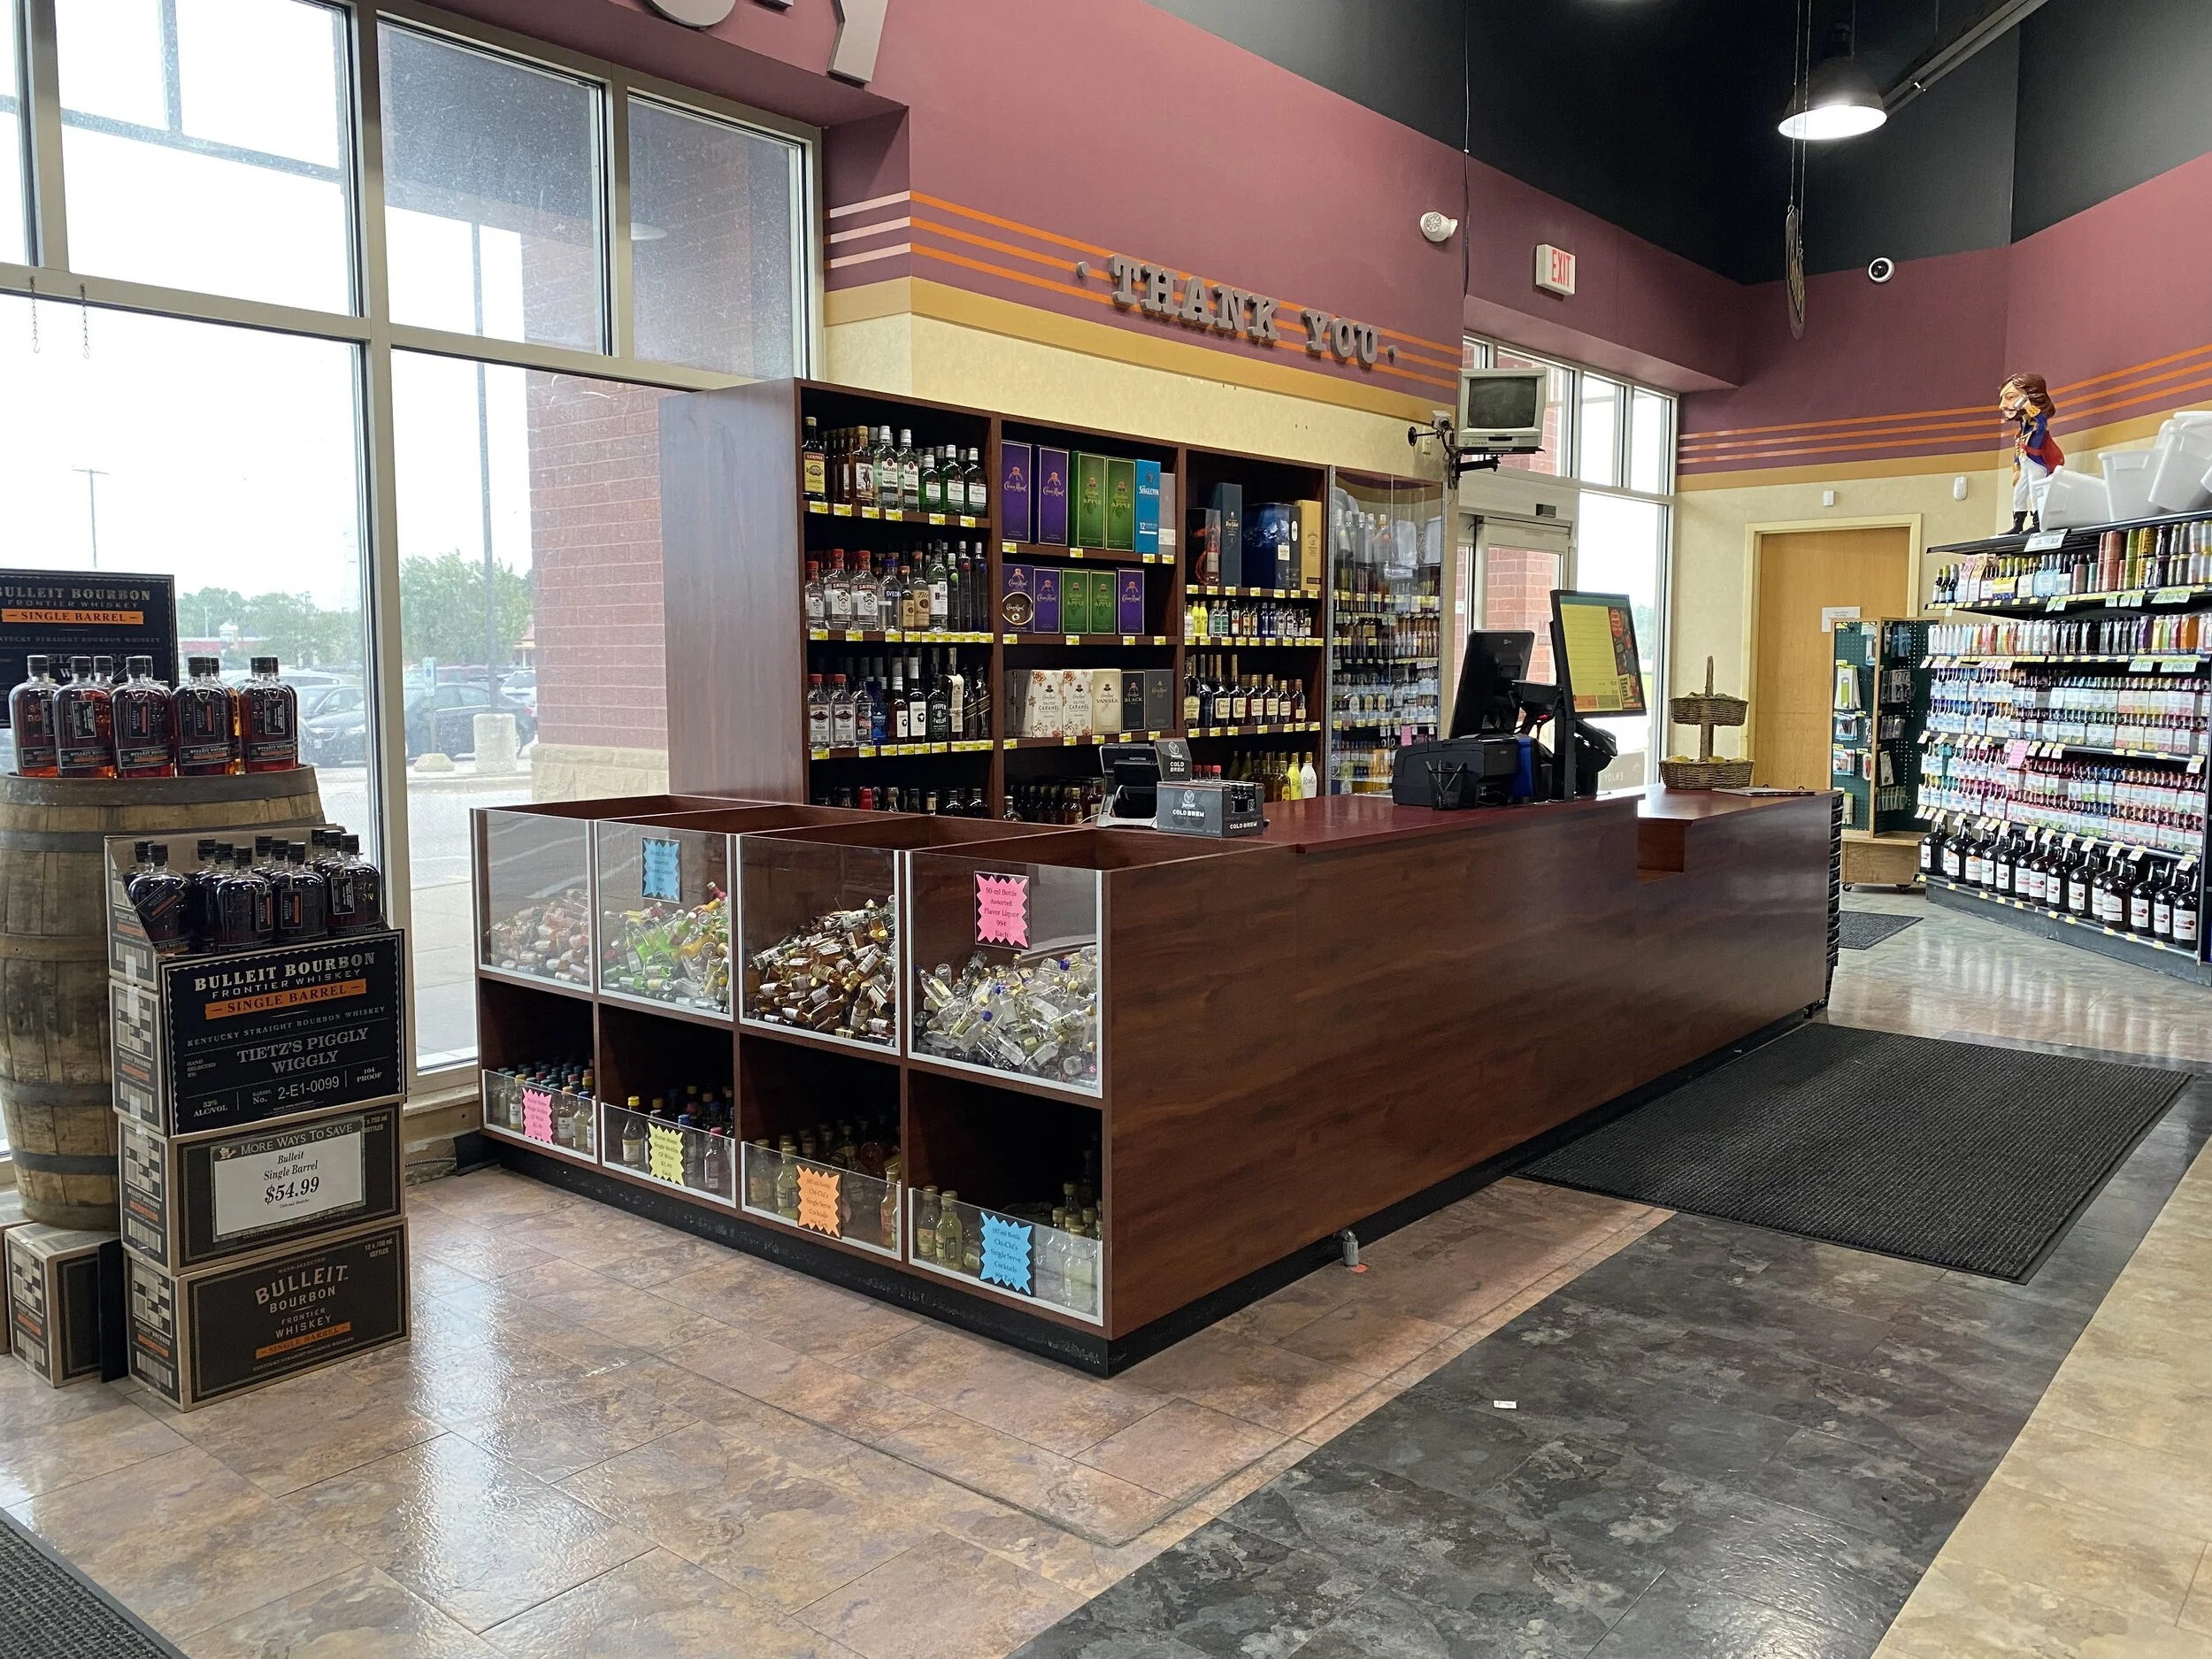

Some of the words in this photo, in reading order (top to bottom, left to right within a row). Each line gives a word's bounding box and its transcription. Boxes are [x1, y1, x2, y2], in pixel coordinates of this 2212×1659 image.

[1551, 249, 1571, 288] EXIT
[1108, 254, 1280, 341] THANK
[1301, 307, 1381, 364] YOU
[0, 586, 65, 599] ULLEIT
[71, 588, 150, 602] BOURBON
[21, 611, 70, 620] SINGLE
[75, 612, 126, 622] BARREL
[990, 898, 1012, 907] Assorted
[1002, 910, 1019, 918] Liquor
[194, 966, 277, 992] BULLEIT
[285, 952, 375, 978] BOURBON
[212, 979, 288, 999] FRONTIER
[296, 969, 361, 986] WHISKEY
[227, 992, 283, 1013] SINGLE
[289, 984, 347, 1005] BARREL
[188, 1032, 239, 1047] KENTUCKY
[243, 1022, 292, 1037] STRAIGHT
[296, 1013, 341, 1027] BOURBON
[345, 1006, 386, 1018] WHISKEY
[237, 1040, 303, 1064] TIETZ'S
[307, 1027, 369, 1051] PIGGLY
[272, 1050, 339, 1074] WIGGLY
[278, 1076, 340, 1100] 2-E1-0099
[357, 1071, 382, 1083] PROOF
[193, 1104, 228, 1118] ALC/VOL
[253, 1096, 268, 1105] No.
[241, 1140, 273, 1156] MORE
[276, 1133, 306, 1148] WAYS
[326, 1123, 353, 1139] SAVE
[277, 1151, 304, 1164] Bulleit
[263, 1166, 290, 1182] Single
[291, 1160, 318, 1176] Barrel
[265, 1176, 320, 1205] $54.99
[991, 1248, 1006, 1258] Single
[1007, 1254, 1021, 1263] Serve
[994, 1260, 1018, 1273] Cocktails
[255, 1264, 348, 1305] BULLEIT
[269, 1286, 335, 1314] BOURBON
[275, 1315, 332, 1339] WHISKEY
[281, 1307, 326, 1325] FRONTIER
[268, 1336, 303, 1354] SINGLE
[307, 1326, 339, 1344] BARREL
